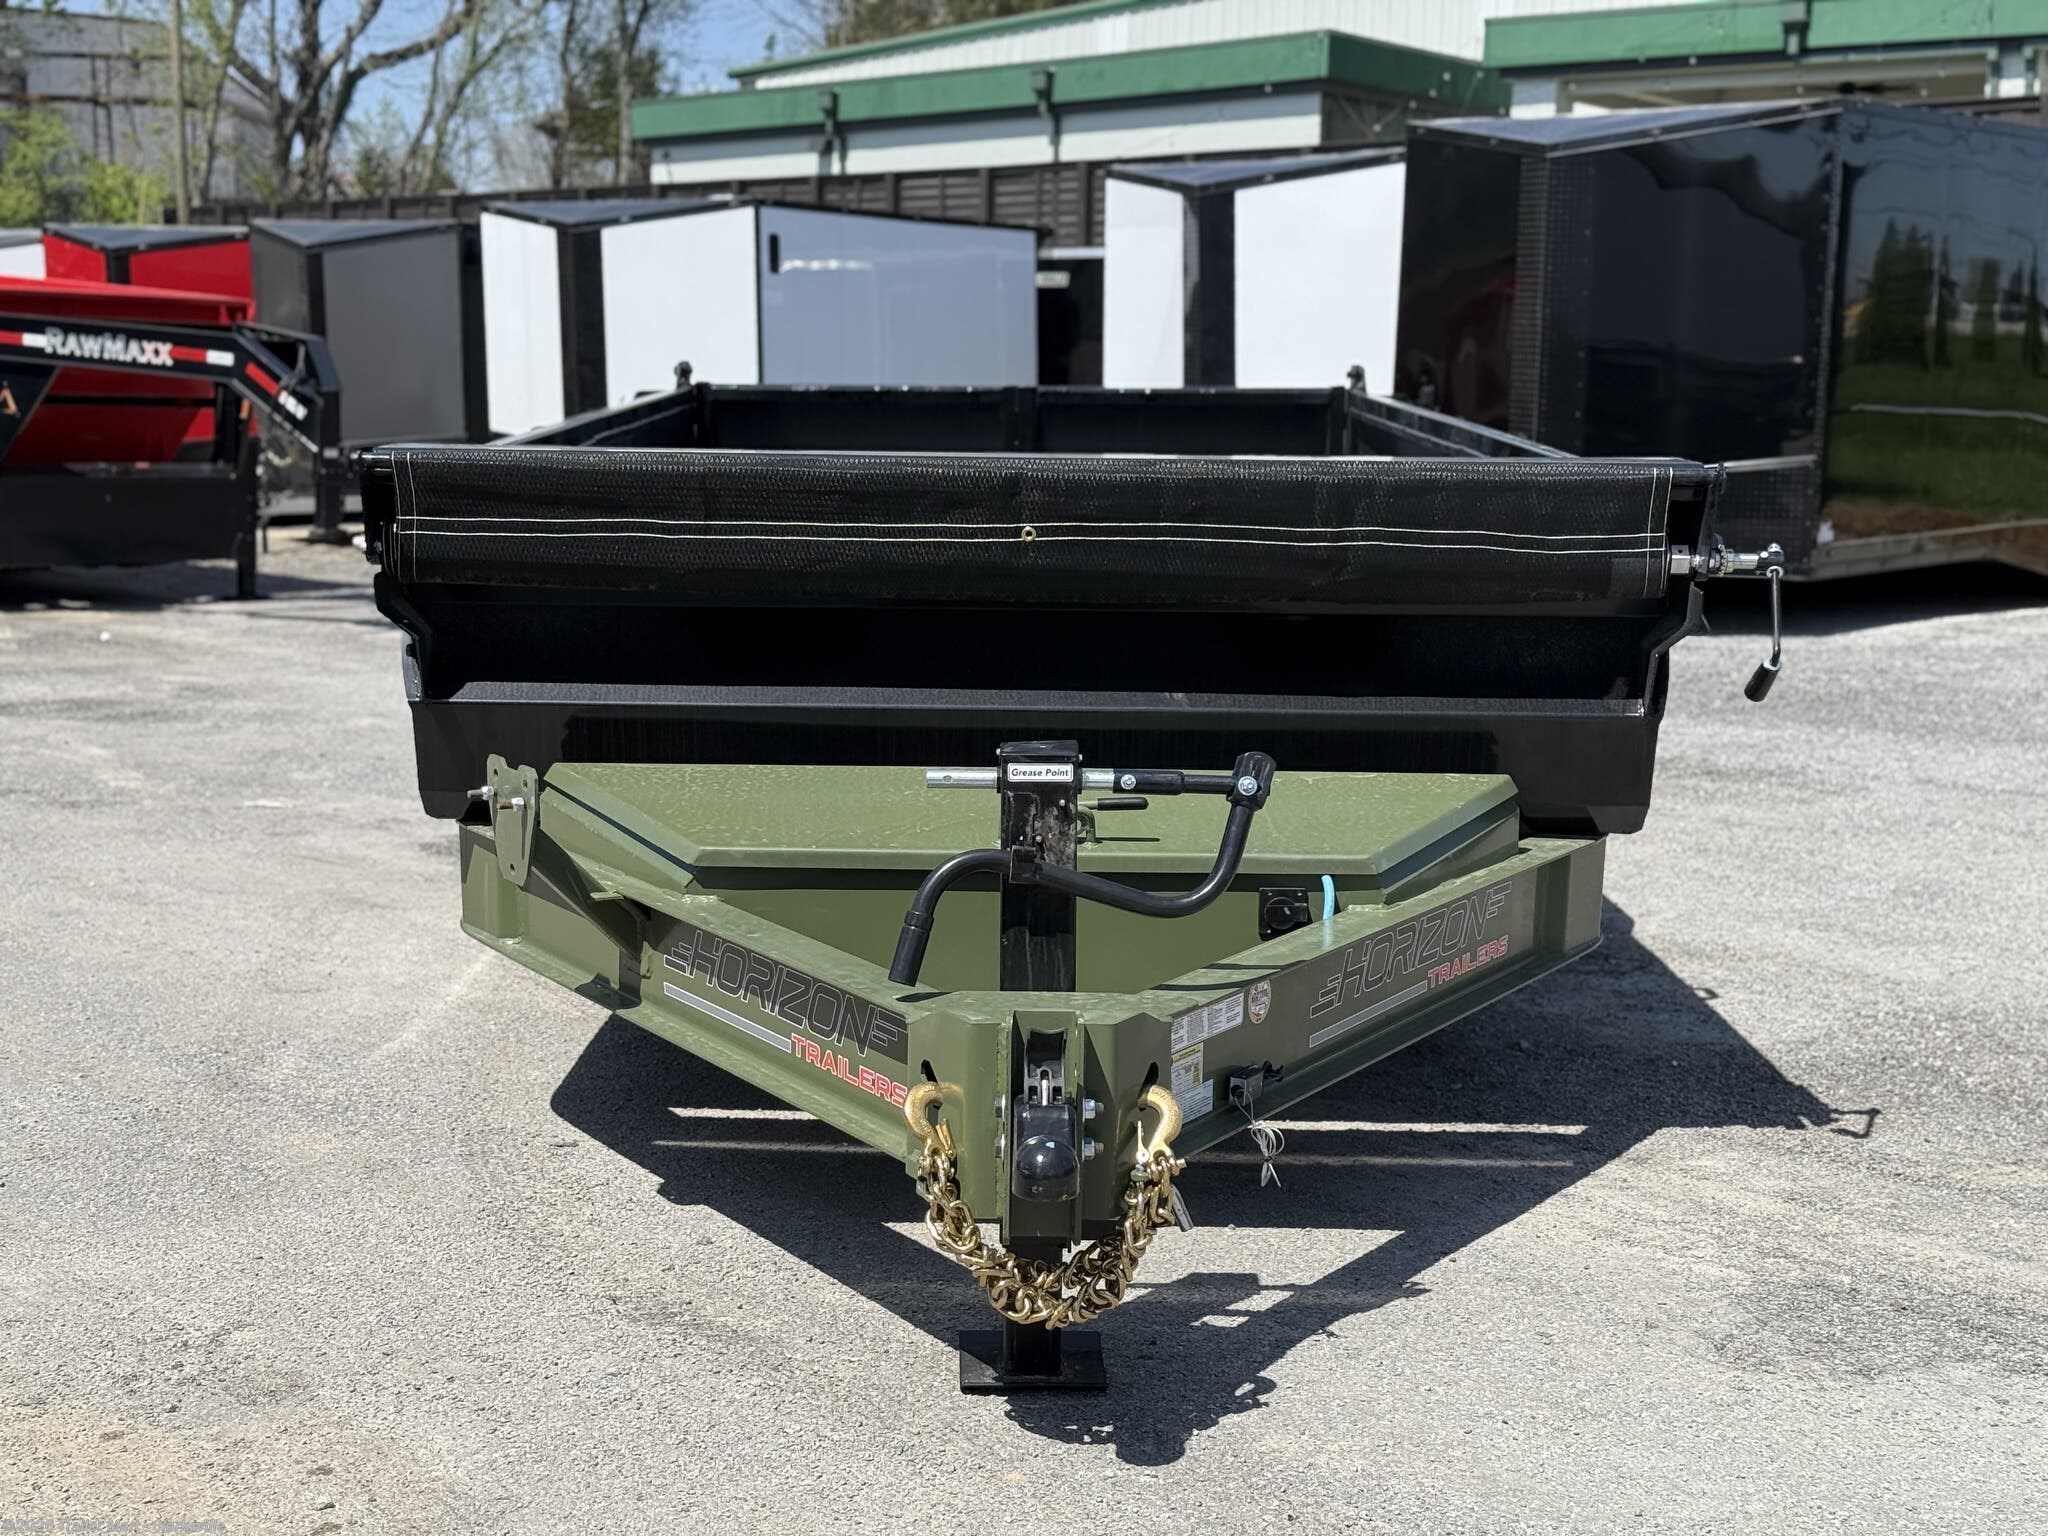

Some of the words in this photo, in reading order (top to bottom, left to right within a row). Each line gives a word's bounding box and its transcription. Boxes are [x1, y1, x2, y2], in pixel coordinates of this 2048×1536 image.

[1011, 768, 1043, 777] Grease
[1045, 768, 1069, 777] Point
[1334, 888, 1494, 1007] HORIZON
[1427, 934, 1509, 989] TRAILERS
[687, 929, 878, 1058] HORIZON
[791, 1032, 908, 1109] TRAILERS
